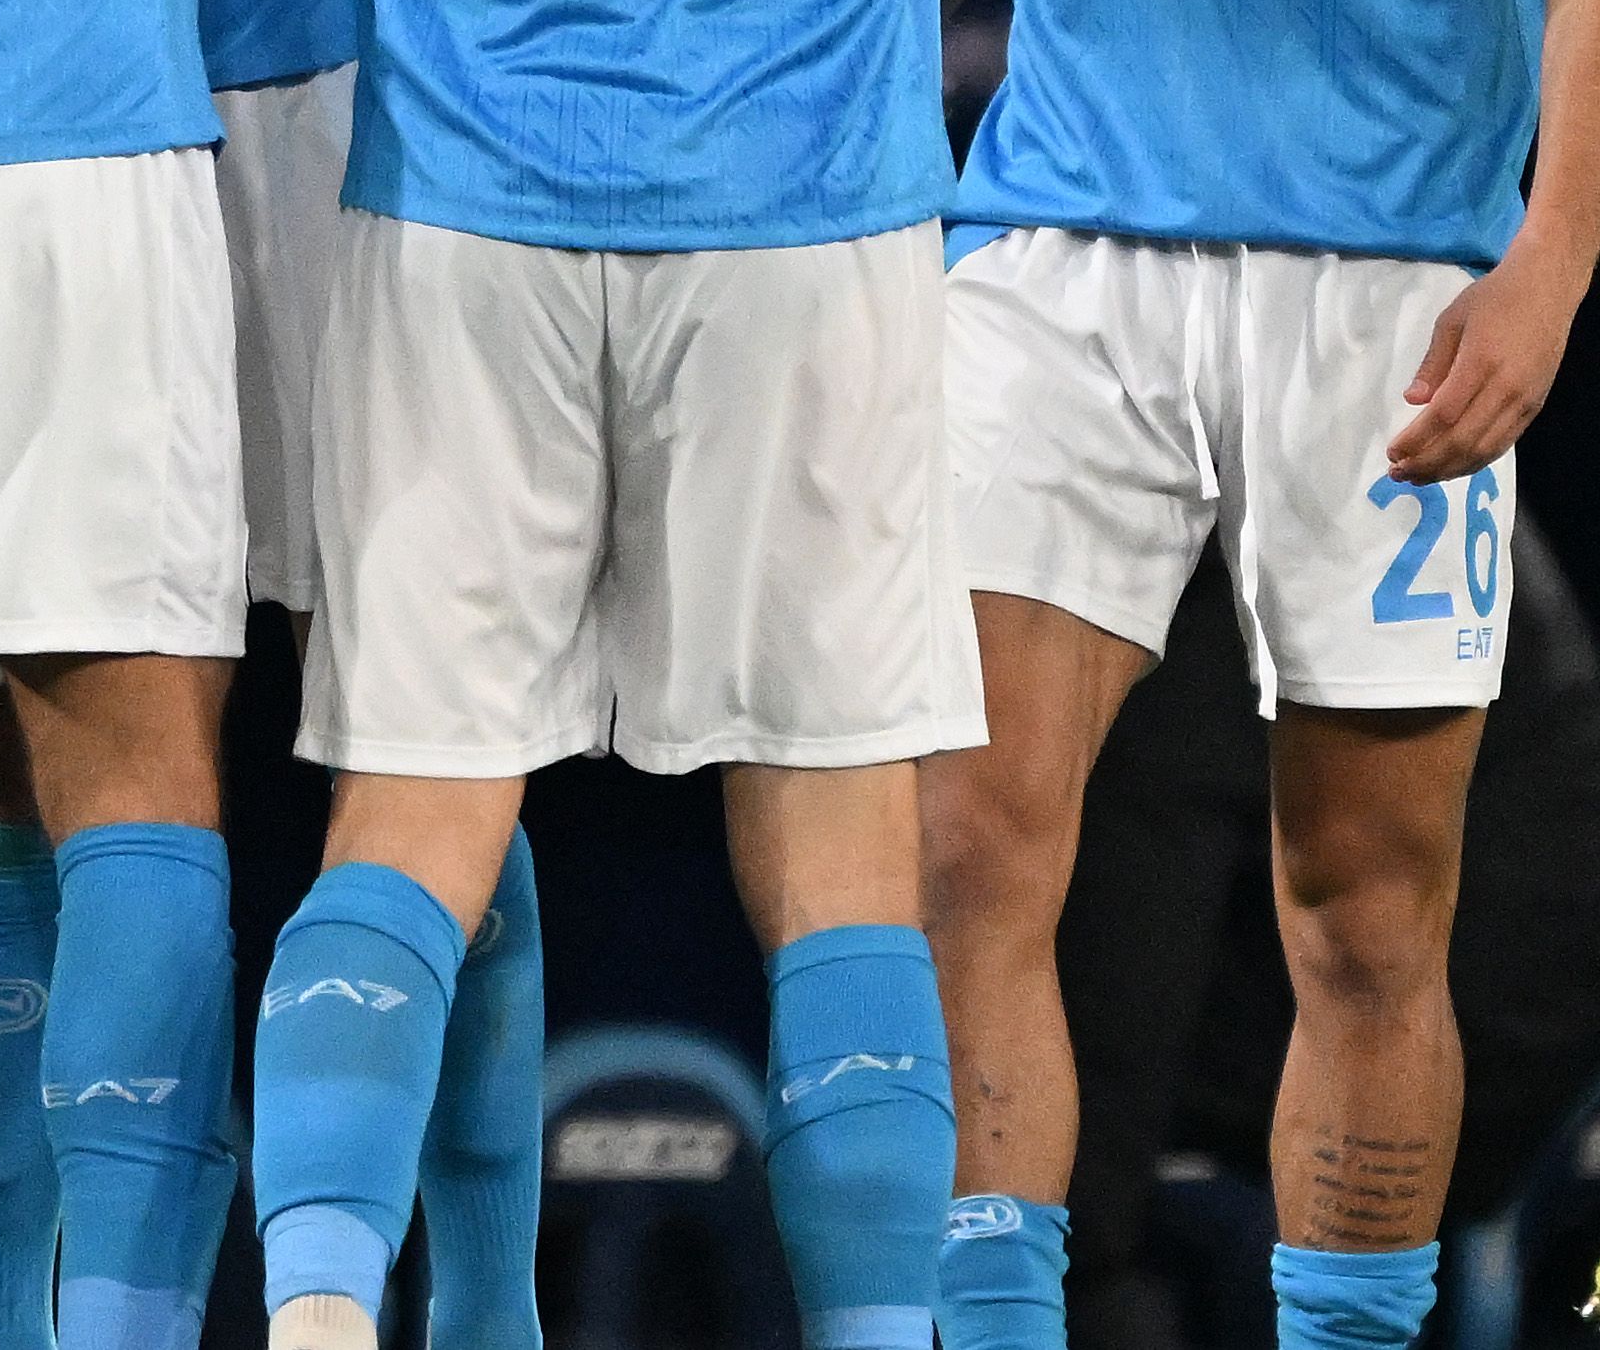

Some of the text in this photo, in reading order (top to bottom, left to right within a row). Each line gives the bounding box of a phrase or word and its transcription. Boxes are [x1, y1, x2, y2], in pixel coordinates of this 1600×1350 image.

[1367, 465, 1500, 625] 26
[1457, 627, 1493, 660] EA7
[261, 978, 409, 1020] EA7
[42, 1078, 180, 1109] EA7
